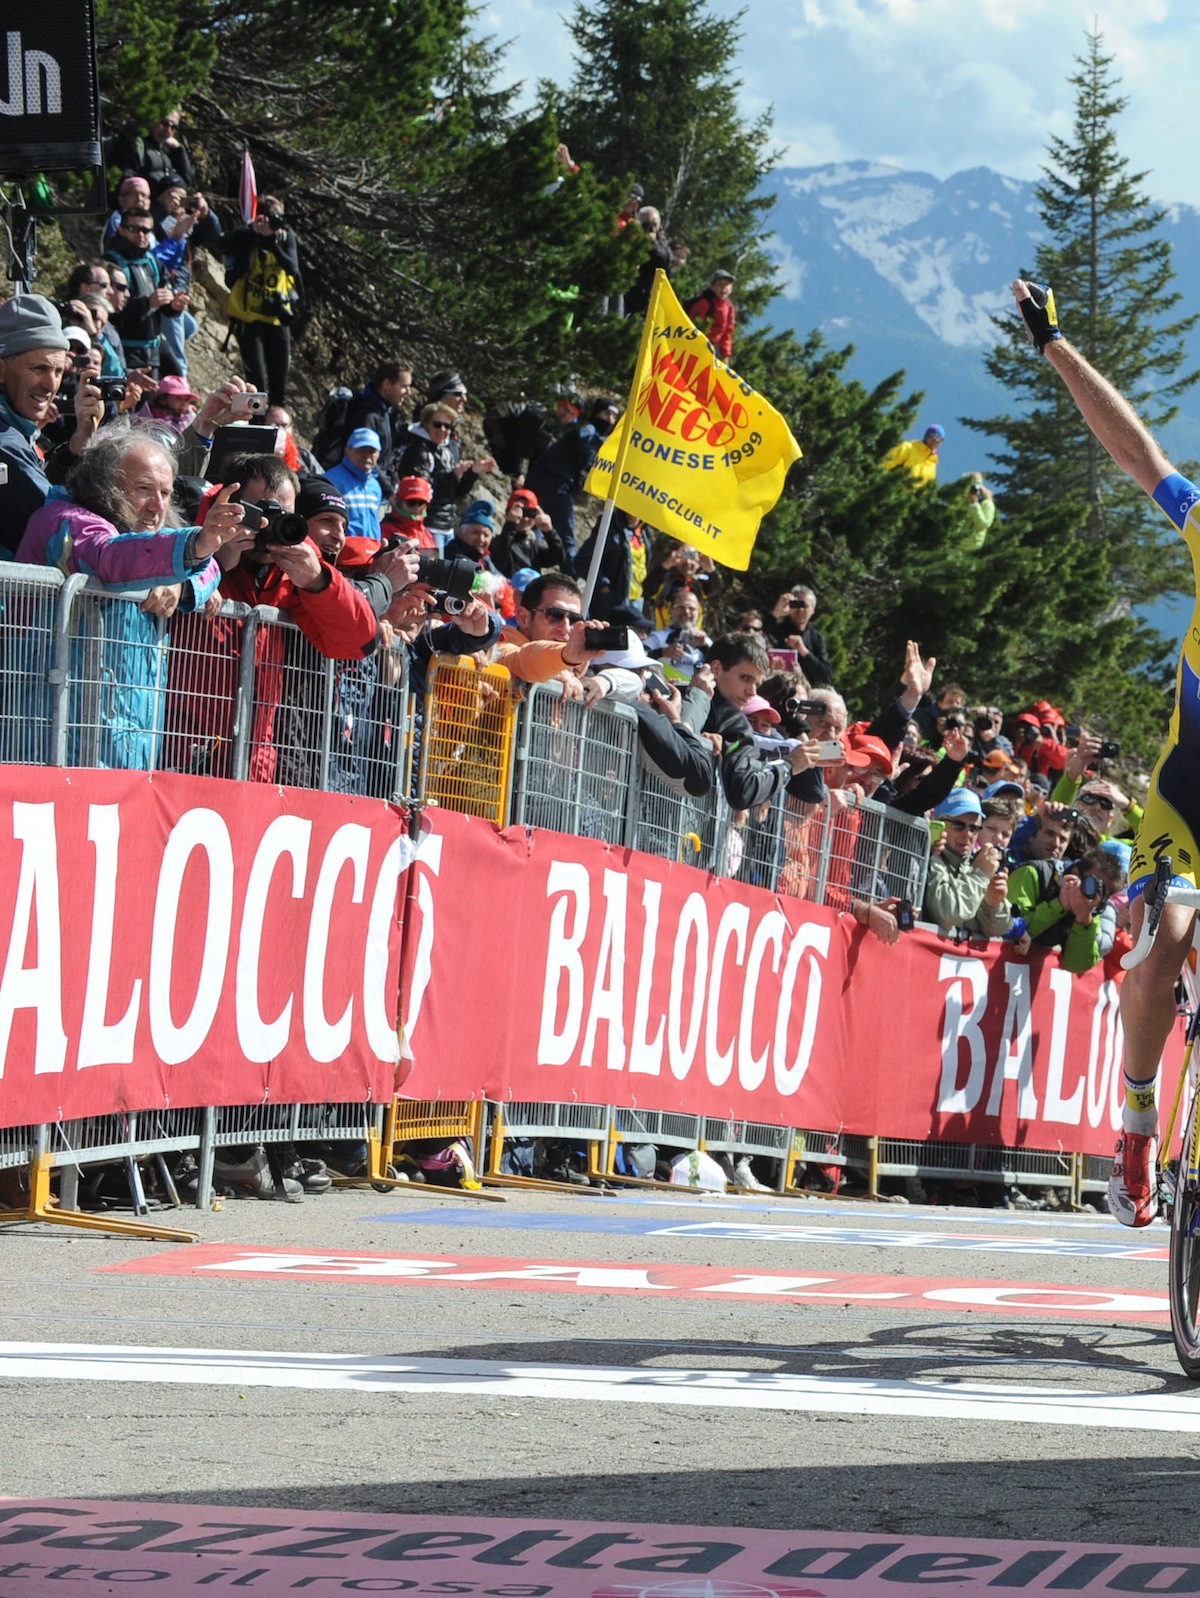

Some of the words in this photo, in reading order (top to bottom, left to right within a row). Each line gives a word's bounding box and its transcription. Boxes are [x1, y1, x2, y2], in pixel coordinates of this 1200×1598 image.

[721, 432, 762, 468] 1999
[537, 860, 831, 1096] BALOCCO
[0, 1507, 745, 1574] Gazzetta
[291, 1575, 554, 1597] rosa
